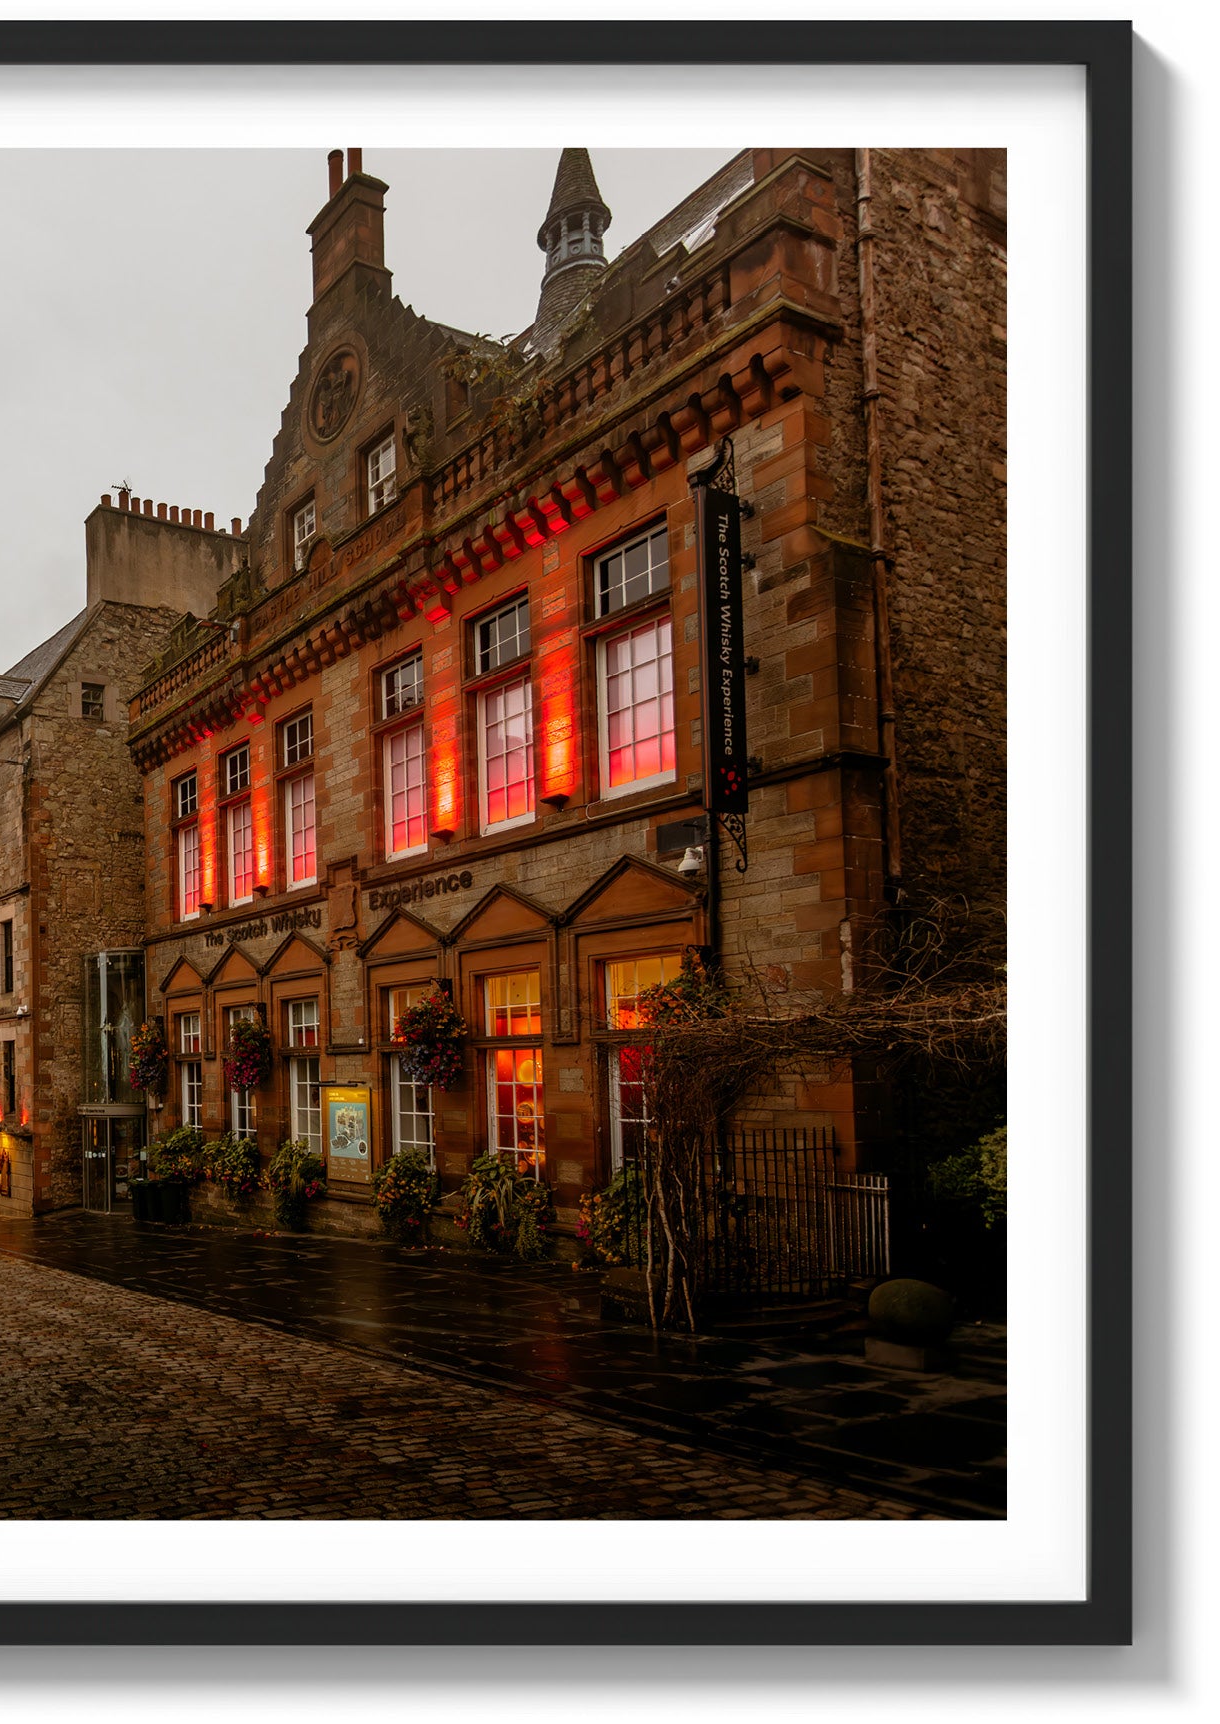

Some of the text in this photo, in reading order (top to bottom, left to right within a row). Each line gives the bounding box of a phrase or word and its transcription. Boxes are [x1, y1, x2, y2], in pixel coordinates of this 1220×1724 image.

[307, 558, 338, 594] HILL
[717, 513, 734, 757] The Scotch Whisky Experience
[204, 869, 473, 947] The Scotch Whisky Experience
